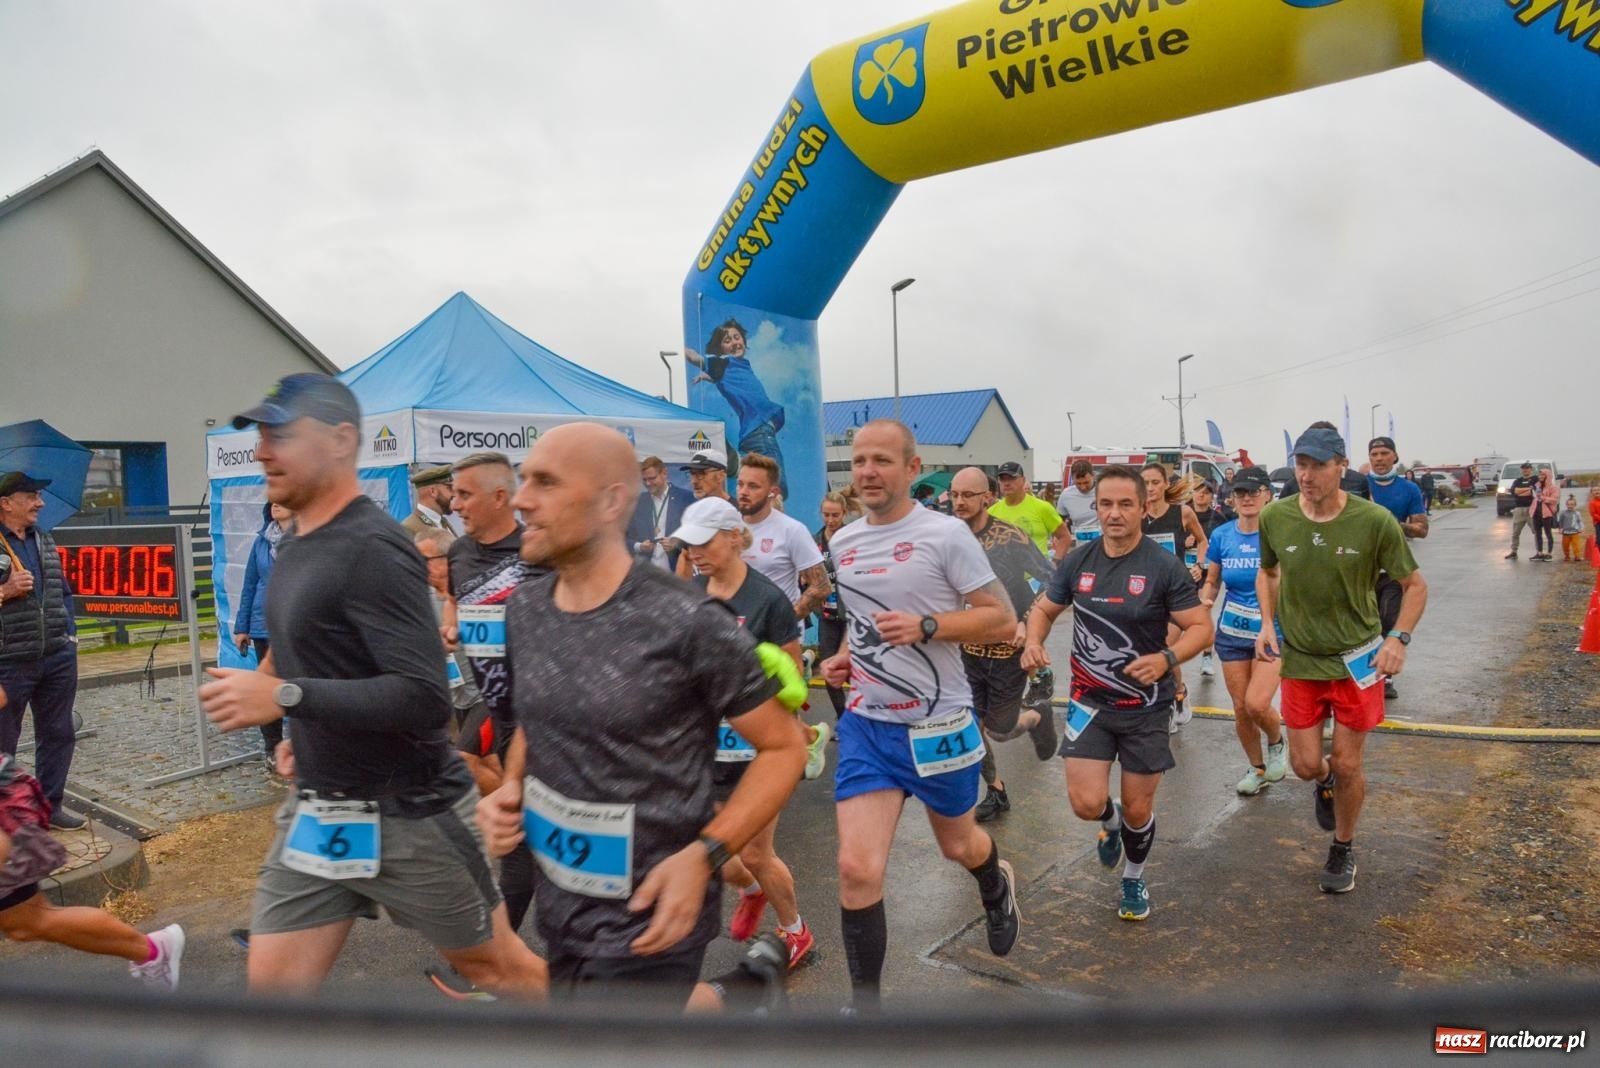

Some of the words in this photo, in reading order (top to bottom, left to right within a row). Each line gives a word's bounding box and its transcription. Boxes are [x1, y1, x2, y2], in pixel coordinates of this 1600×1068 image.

[989, 25, 1190, 100] Wielkie
[697, 181, 755, 272] Gmina
[751, 96, 804, 180] ludzi
[718, 124, 828, 293] aktywnych
[374, 438, 397, 452] MITKO
[440, 424, 542, 449] PersonalB
[85, 601, 179, 617] www.personalbest.pl
[465, 622, 489, 643] 70
[1232, 615, 1250, 630] 68
[718, 729, 737, 749] 6
[936, 732, 970, 758] 41
[545, 827, 592, 868] 49
